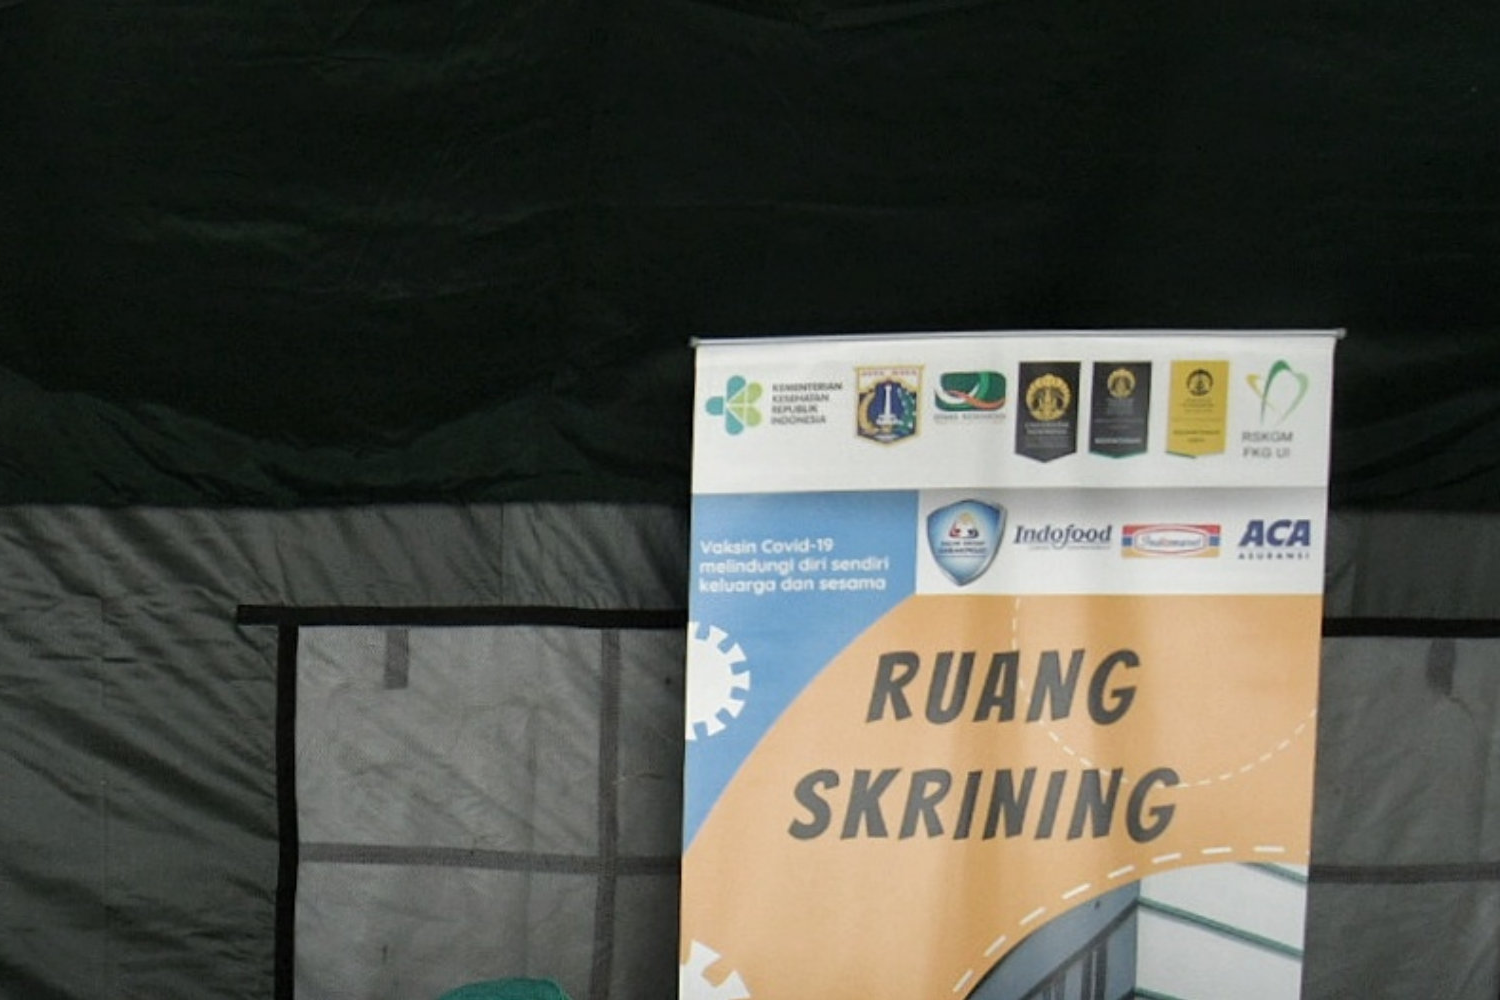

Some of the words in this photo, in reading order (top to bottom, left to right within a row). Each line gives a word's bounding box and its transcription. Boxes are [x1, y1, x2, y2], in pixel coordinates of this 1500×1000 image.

[772, 382, 843, 392] KEMENTERIAN
[772, 393, 830, 403] KESEHATAN
[771, 405, 818, 414] REPUBLIK
[771, 415, 826, 425] INDONESIA
[1014, 524, 1112, 550] Indofood
[1238, 519, 1311, 547] ACA
[700, 540, 757, 554] Vaksin
[761, 537, 834, 553] Covid-19
[1238, 552, 1310, 560] ASURANSI
[699, 557, 794, 576] melindungi
[798, 557, 827, 571] diri
[831, 556, 890, 571] sendiri
[699, 577, 776, 595] keluarga
[780, 577, 815, 591] dan
[819, 577, 886, 591] sesama
[866, 648, 1140, 725] RUANG
[788, 767, 1180, 844] SKRINING
